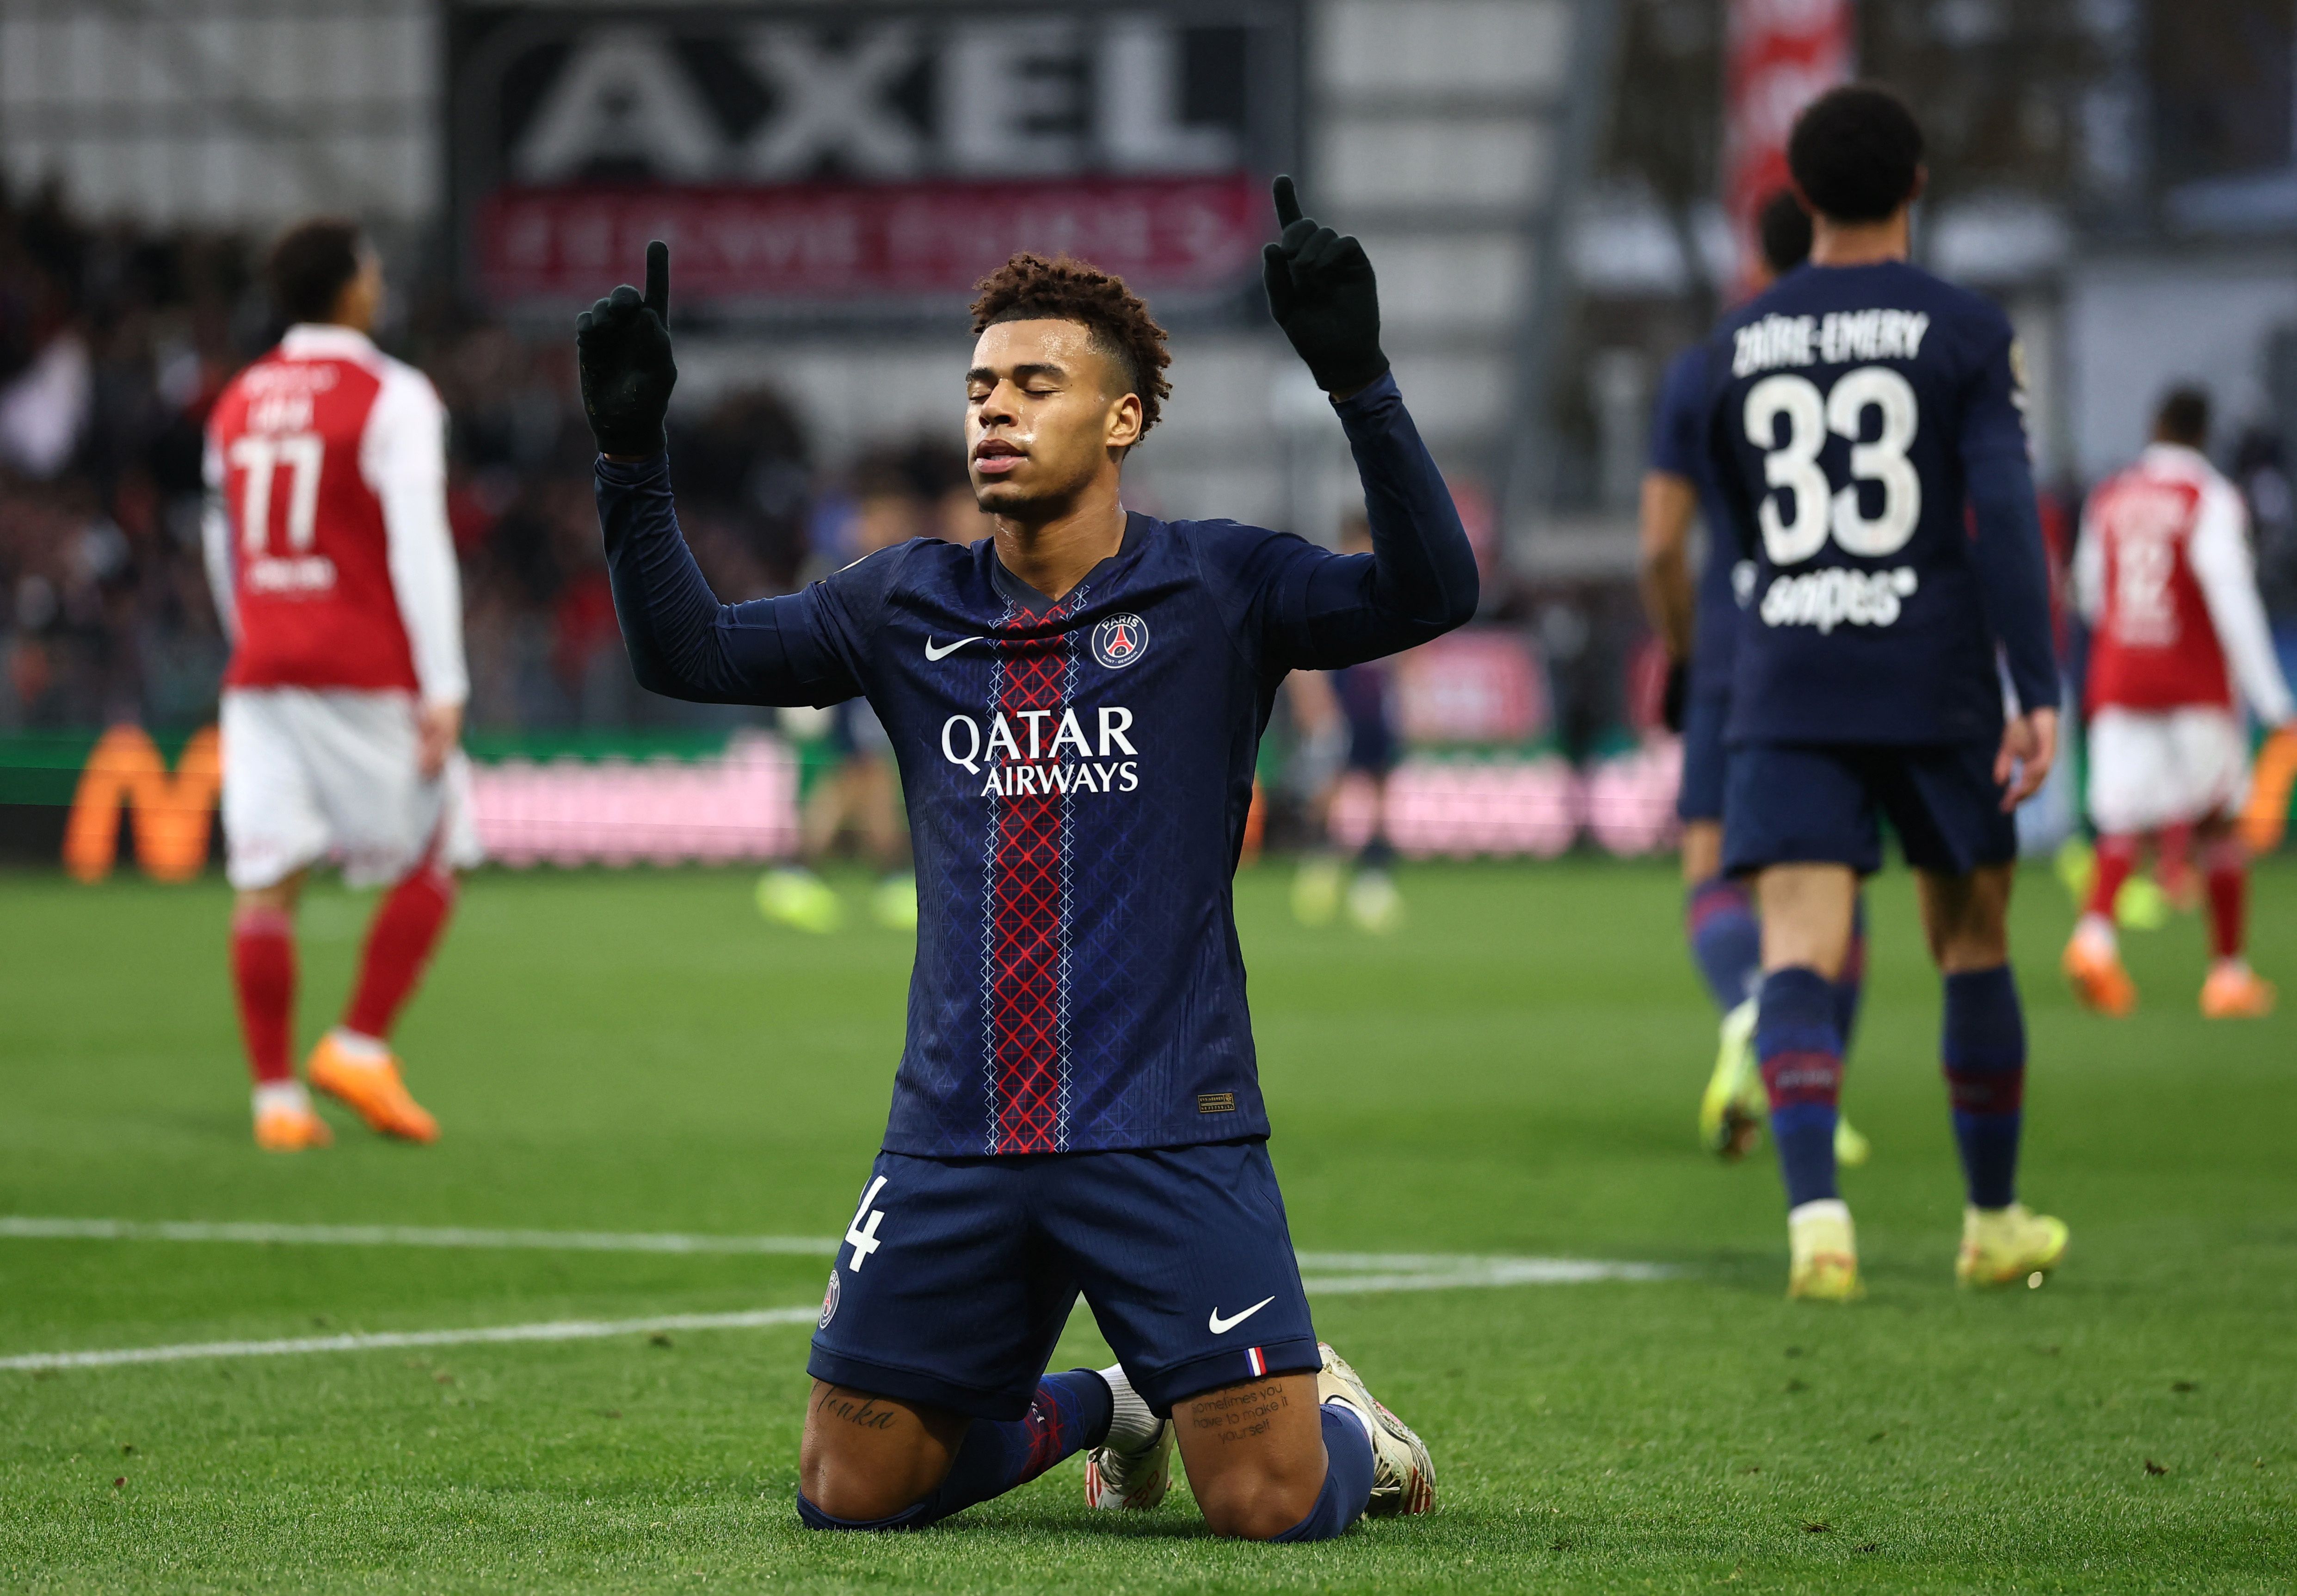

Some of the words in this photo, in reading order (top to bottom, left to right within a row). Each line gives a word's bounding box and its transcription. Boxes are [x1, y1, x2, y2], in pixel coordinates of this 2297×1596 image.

[511, 18, 1240, 183] AXEL
[1743, 365, 1921, 567] 33
[230, 430, 324, 555] 77
[1102, 615, 1139, 630] PARIS
[942, 707, 1138, 775] QATAR
[980, 761, 1138, 797] AIRWAYS
[845, 1175, 887, 1272] 4
[1192, 1392, 1257, 1413] sometimes
[1260, 1383, 1282, 1400] you
[1226, 1413, 1239, 1424] to
[1243, 1402, 1279, 1421] make
[1281, 1396, 1288, 1407] it
[1218, 1418, 1270, 1444] yourself
